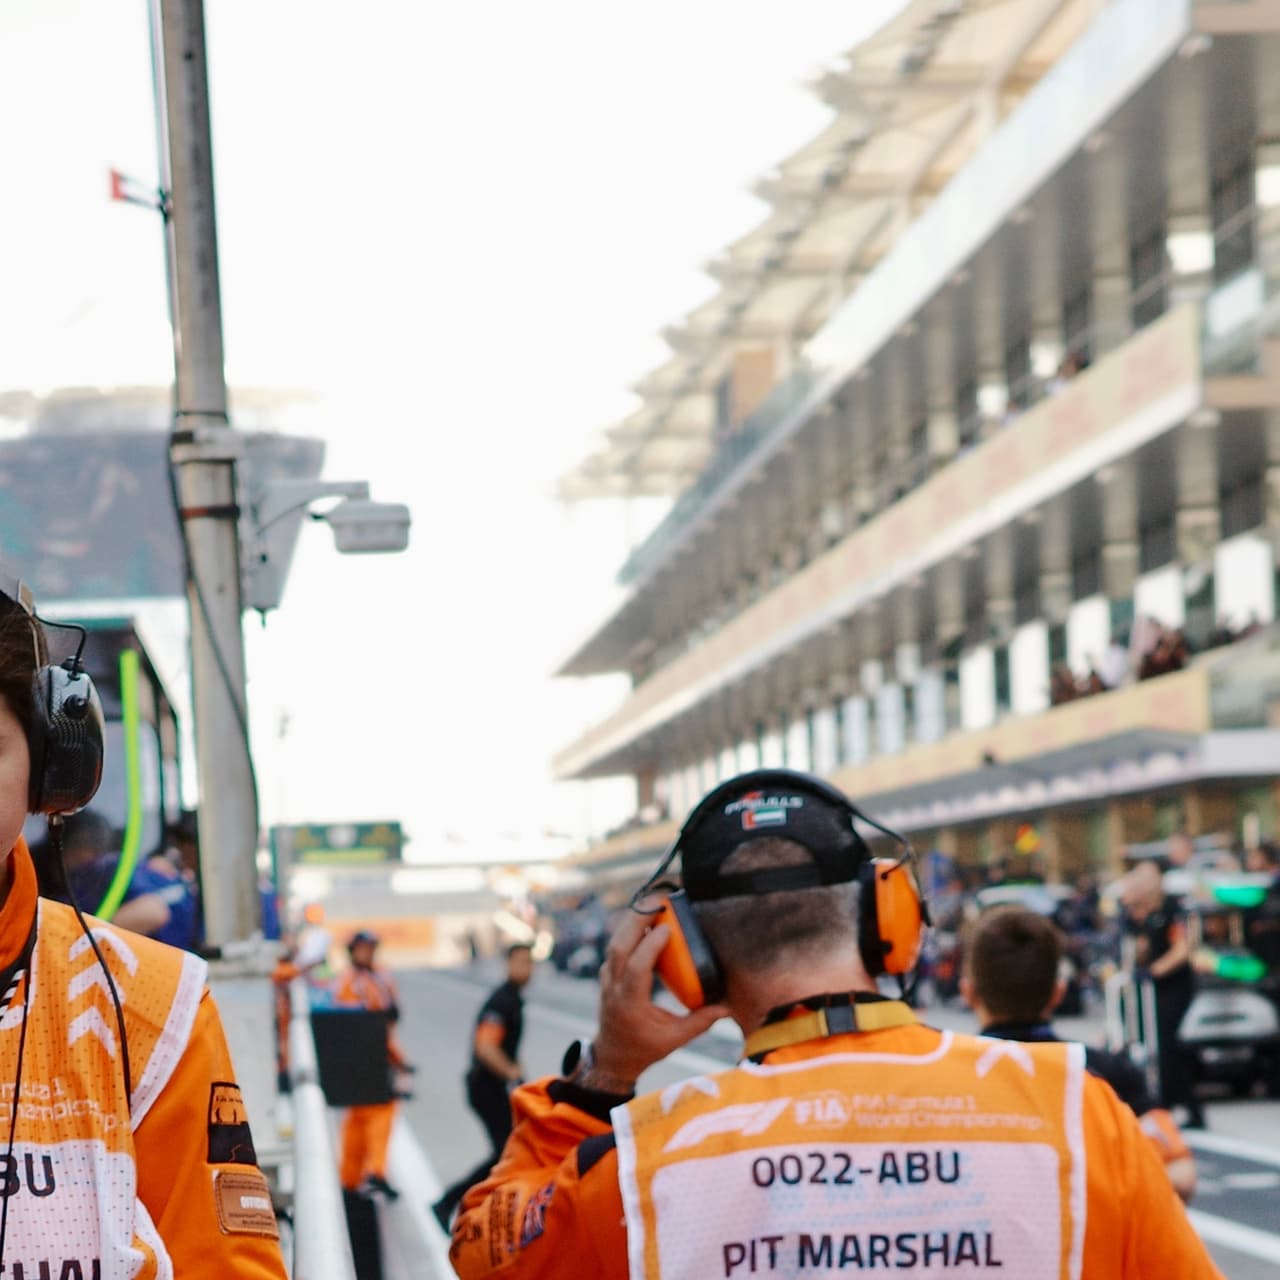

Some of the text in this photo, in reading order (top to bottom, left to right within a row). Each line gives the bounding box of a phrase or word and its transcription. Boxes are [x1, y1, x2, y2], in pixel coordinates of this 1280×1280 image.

[795, 1097, 848, 1125] FIA
[752, 1151, 961, 1188] 0022-ABU
[722, 1232, 1003, 1278] PIT MARSHAL
